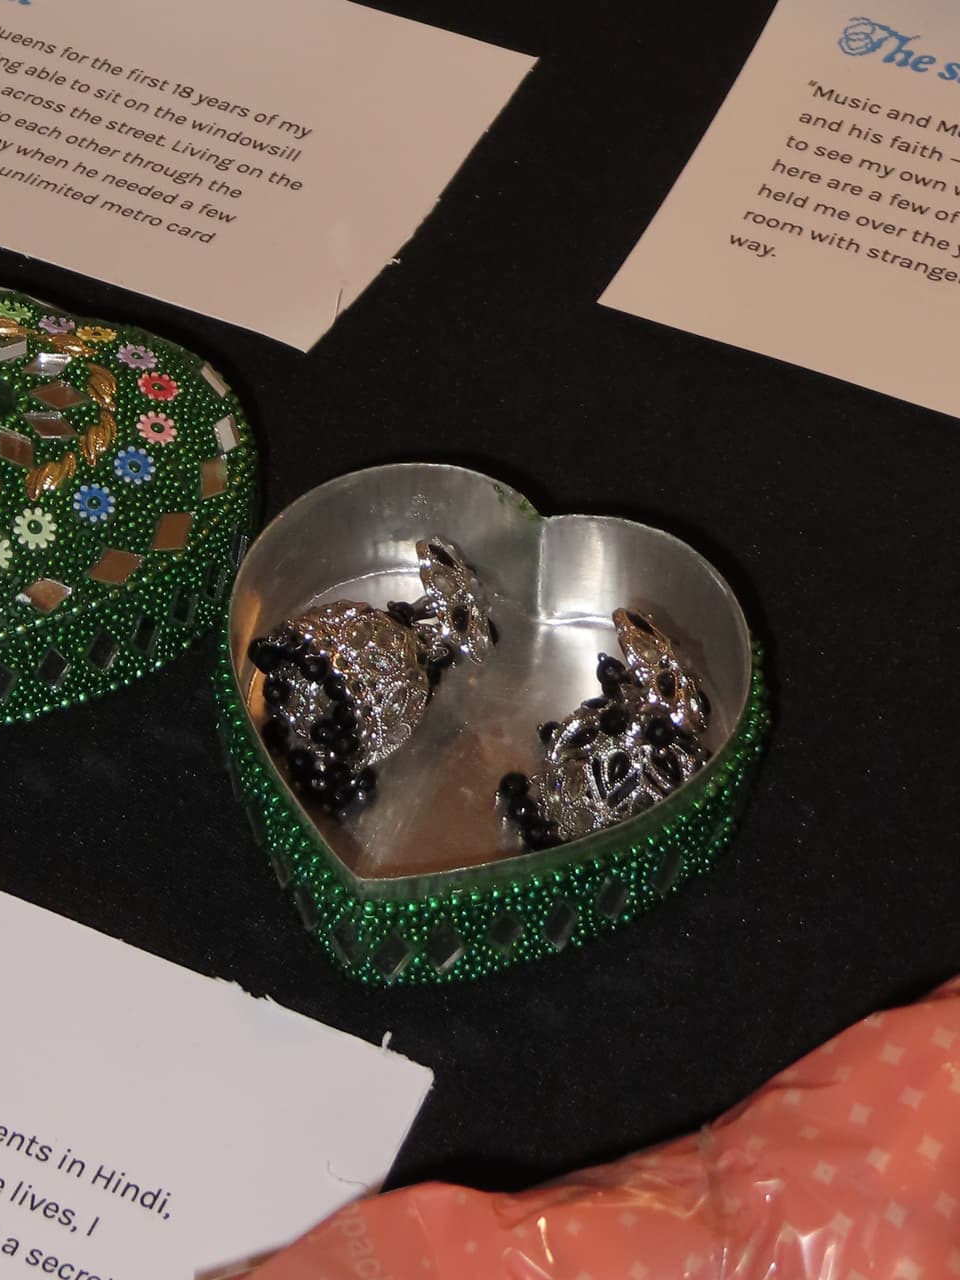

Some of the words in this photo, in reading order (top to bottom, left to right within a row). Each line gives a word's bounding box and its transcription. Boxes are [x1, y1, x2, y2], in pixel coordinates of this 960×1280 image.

[837, 15, 937, 73] The
[24, 66, 67, 86] able
[69, 78, 91, 94] to
[93, 88, 123, 104] sit
[123, 98, 150, 113] on
[153, 105, 188, 126] the
[191, 119, 303, 163] windowsill
[59, 46, 90, 64] for
[90, 56, 124, 76] the
[125, 68, 170, 92] first
[171, 83, 195, 99] 18
[190, 93, 251, 118] years
[253, 112, 280, 126] of
[277, 120, 313, 140] my
[885, 108, 933, 129] and
[785, 135, 809, 152] to
[813, 145, 854, 165] see
[857, 157, 896, 180] my
[898, 170, 948, 193] own
[798, 112, 845, 133] and
[847, 123, 884, 145] his
[889, 135, 944, 163] faith
[756, 183, 810, 209] held
[812, 202, 851, 222] me
[855, 215, 908, 238] over
[911, 229, 951, 251] the
[771, 158, 822, 184] here
[826, 178, 864, 196] are
[867, 190, 883, 203] a
[888, 193, 931, 216] few
[935, 209, 960, 225] of
[729, 234, 777, 258] way.
[742, 210, 804, 237] room
[810, 229, 861, 254] with
[866, 247, 960, 284] strange
[57, 1147, 86, 1179] in
[90, 1164, 172, 1221] Hindi,
